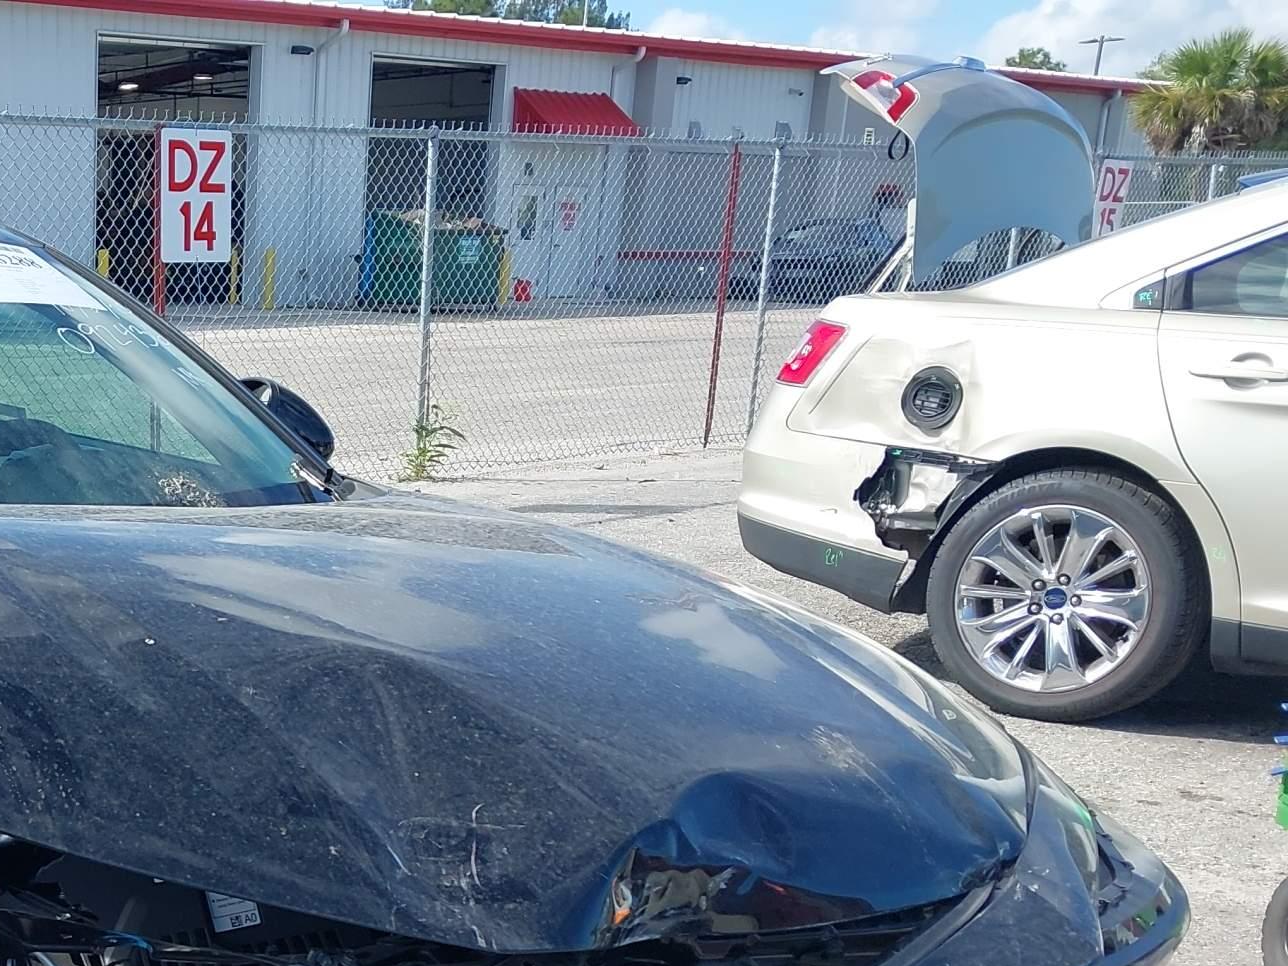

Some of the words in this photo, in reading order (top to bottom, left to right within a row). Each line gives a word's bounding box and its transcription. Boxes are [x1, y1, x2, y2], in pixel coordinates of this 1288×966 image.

[167, 139, 226, 193] DZ
[1098, 166, 1131, 203] DZ
[179, 201, 216, 251] 14
[1098, 207, 1117, 236] 15
